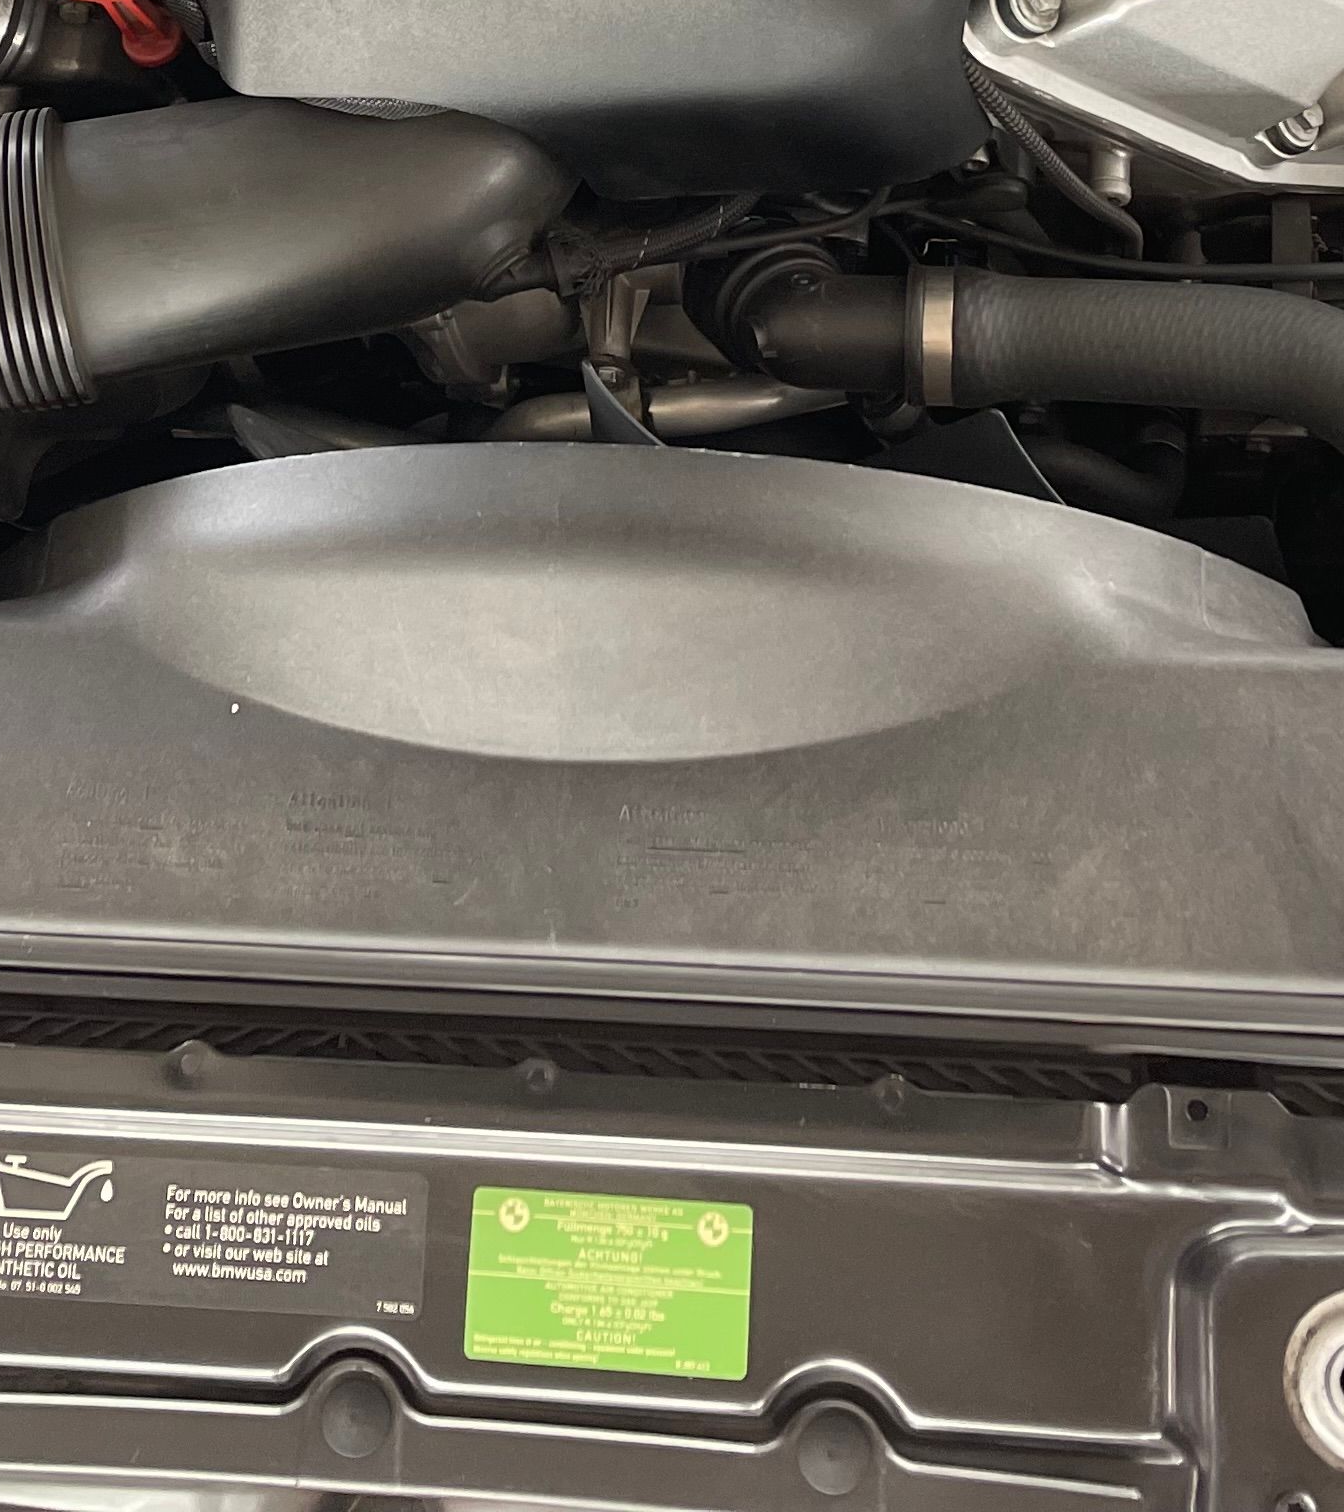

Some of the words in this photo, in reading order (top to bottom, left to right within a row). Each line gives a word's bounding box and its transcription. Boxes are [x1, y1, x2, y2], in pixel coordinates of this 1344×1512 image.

[167, 1184, 190, 1203] For
[194, 1189, 231, 1206] more
[235, 1188, 260, 1207] info
[264, 1193, 288, 1208] see
[293, 1192, 351, 1212] Owner's
[355, 1196, 406, 1216] Manual
[165, 1203, 189, 1221] For
[192, 1208, 201, 1222] a
[205, 1205, 225, 1223] list
[230, 1206, 244, 1224] of
[246, 1208, 284, 1226] other
[287, 1211, 352, 1233] approved
[355, 1215, 381, 1233] oils
[3, 1222, 30, 1239] Use
[32, 1225, 62, 1244] only
[176, 1223, 200, 1240] call
[15, 1241, 127, 1264] PERFORMANCE
[174, 1245, 189, 1257] or
[192, 1242, 221, 1259] visit
[225, 1247, 249, 1262] our
[253, 1246, 282, 1264] web
[286, 1248, 311, 1265] site
[315, 1251, 328, 1266] at
[577, 1248, 644, 1264] ACHTUNG!
[57, 1262, 81, 1280] OIL
[172, 1261, 307, 1283] www.bmwusa.com
[577, 1331, 636, 1345] CAUTION!
